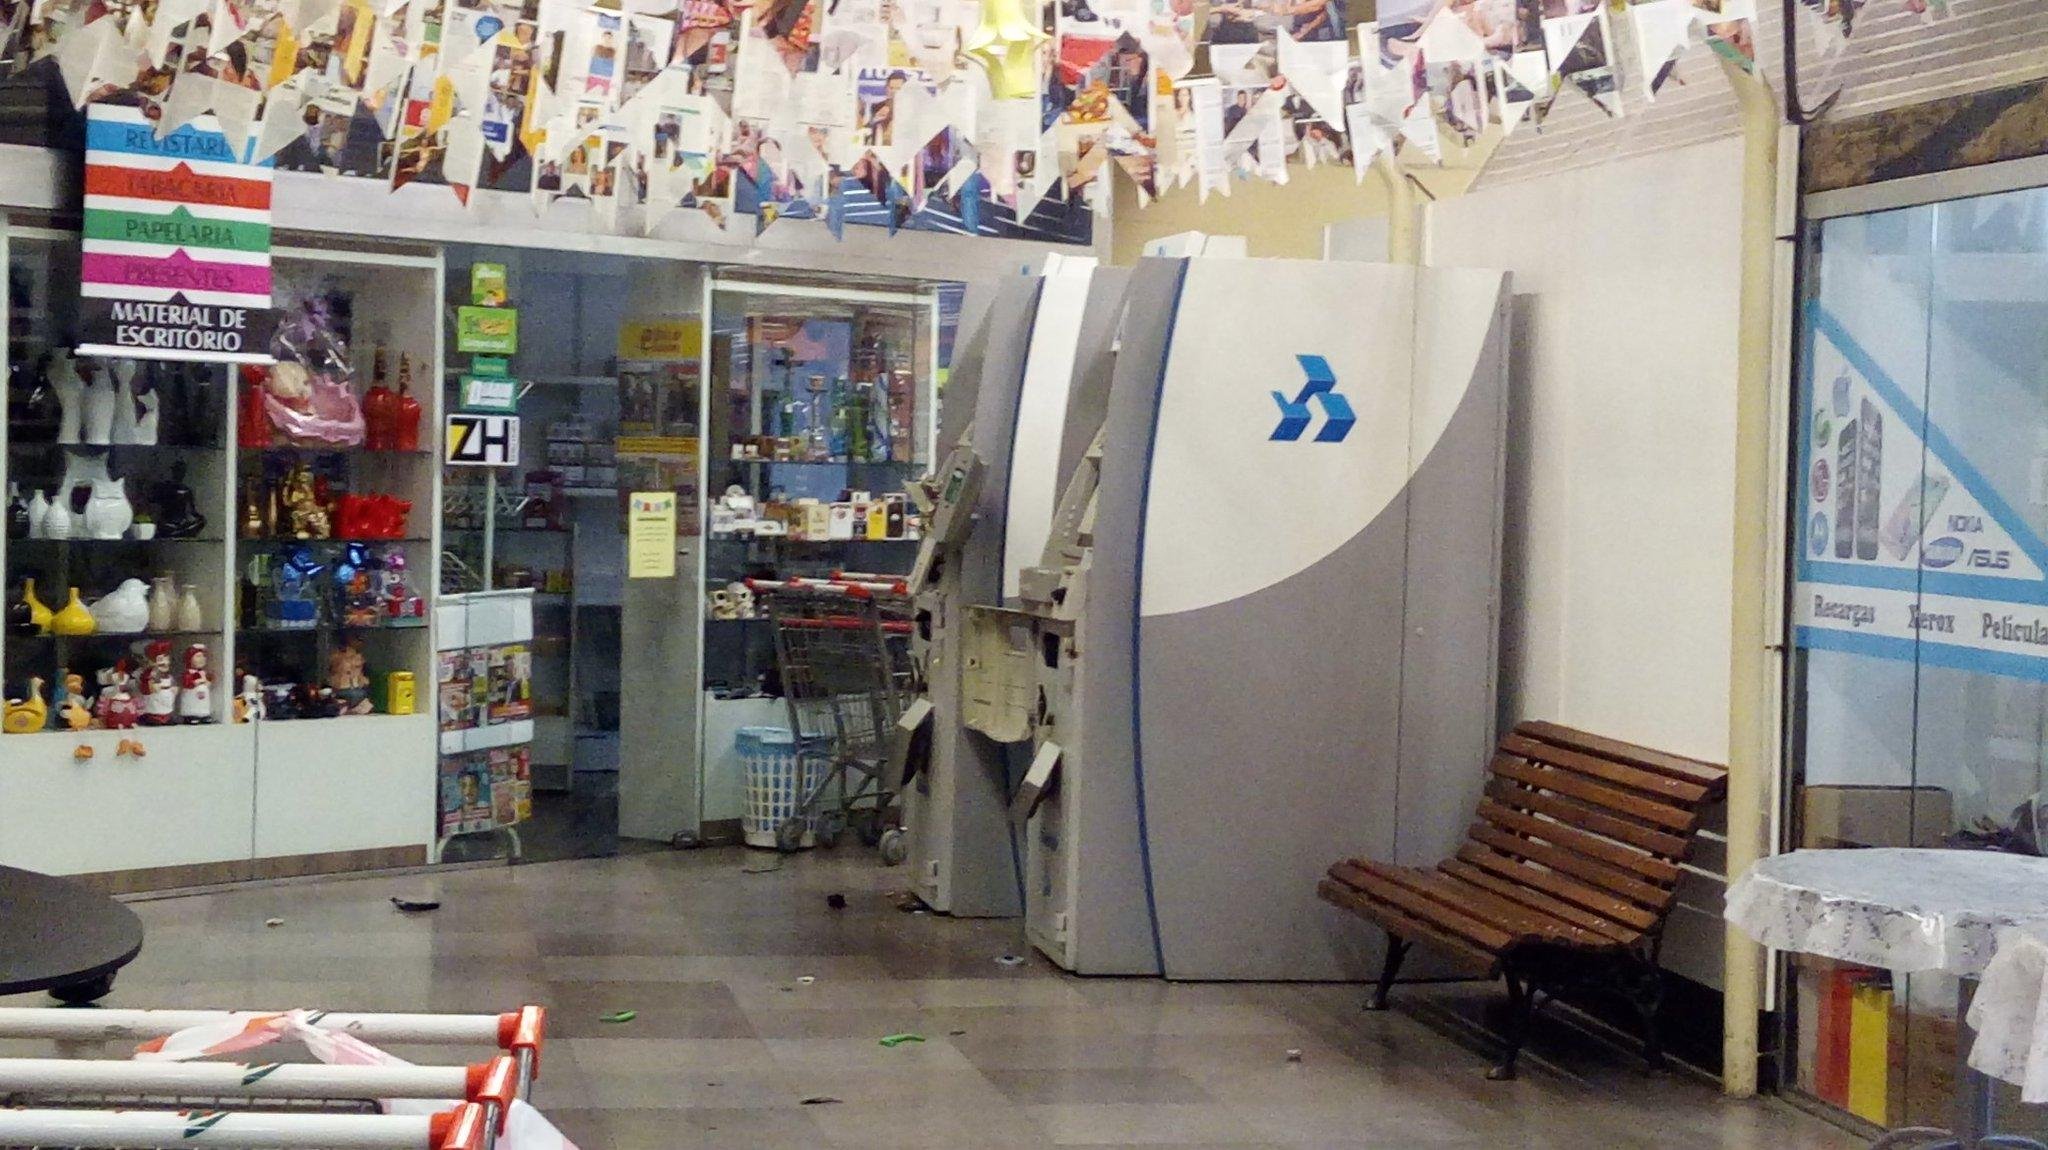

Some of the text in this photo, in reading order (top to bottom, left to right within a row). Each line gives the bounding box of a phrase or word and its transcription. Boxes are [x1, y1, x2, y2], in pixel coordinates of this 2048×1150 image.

[126, 219, 235, 245] PAPELARIA
[125, 262, 234, 289] PRESENTES
[111, 302, 247, 329] MATERIAL DE
[116, 325, 242, 351] ESCRITÓRIO
[451, 417, 510, 462] ZH
[1814, 595, 1875, 627] Recargas
[1908, 604, 1955, 633] Xerox
